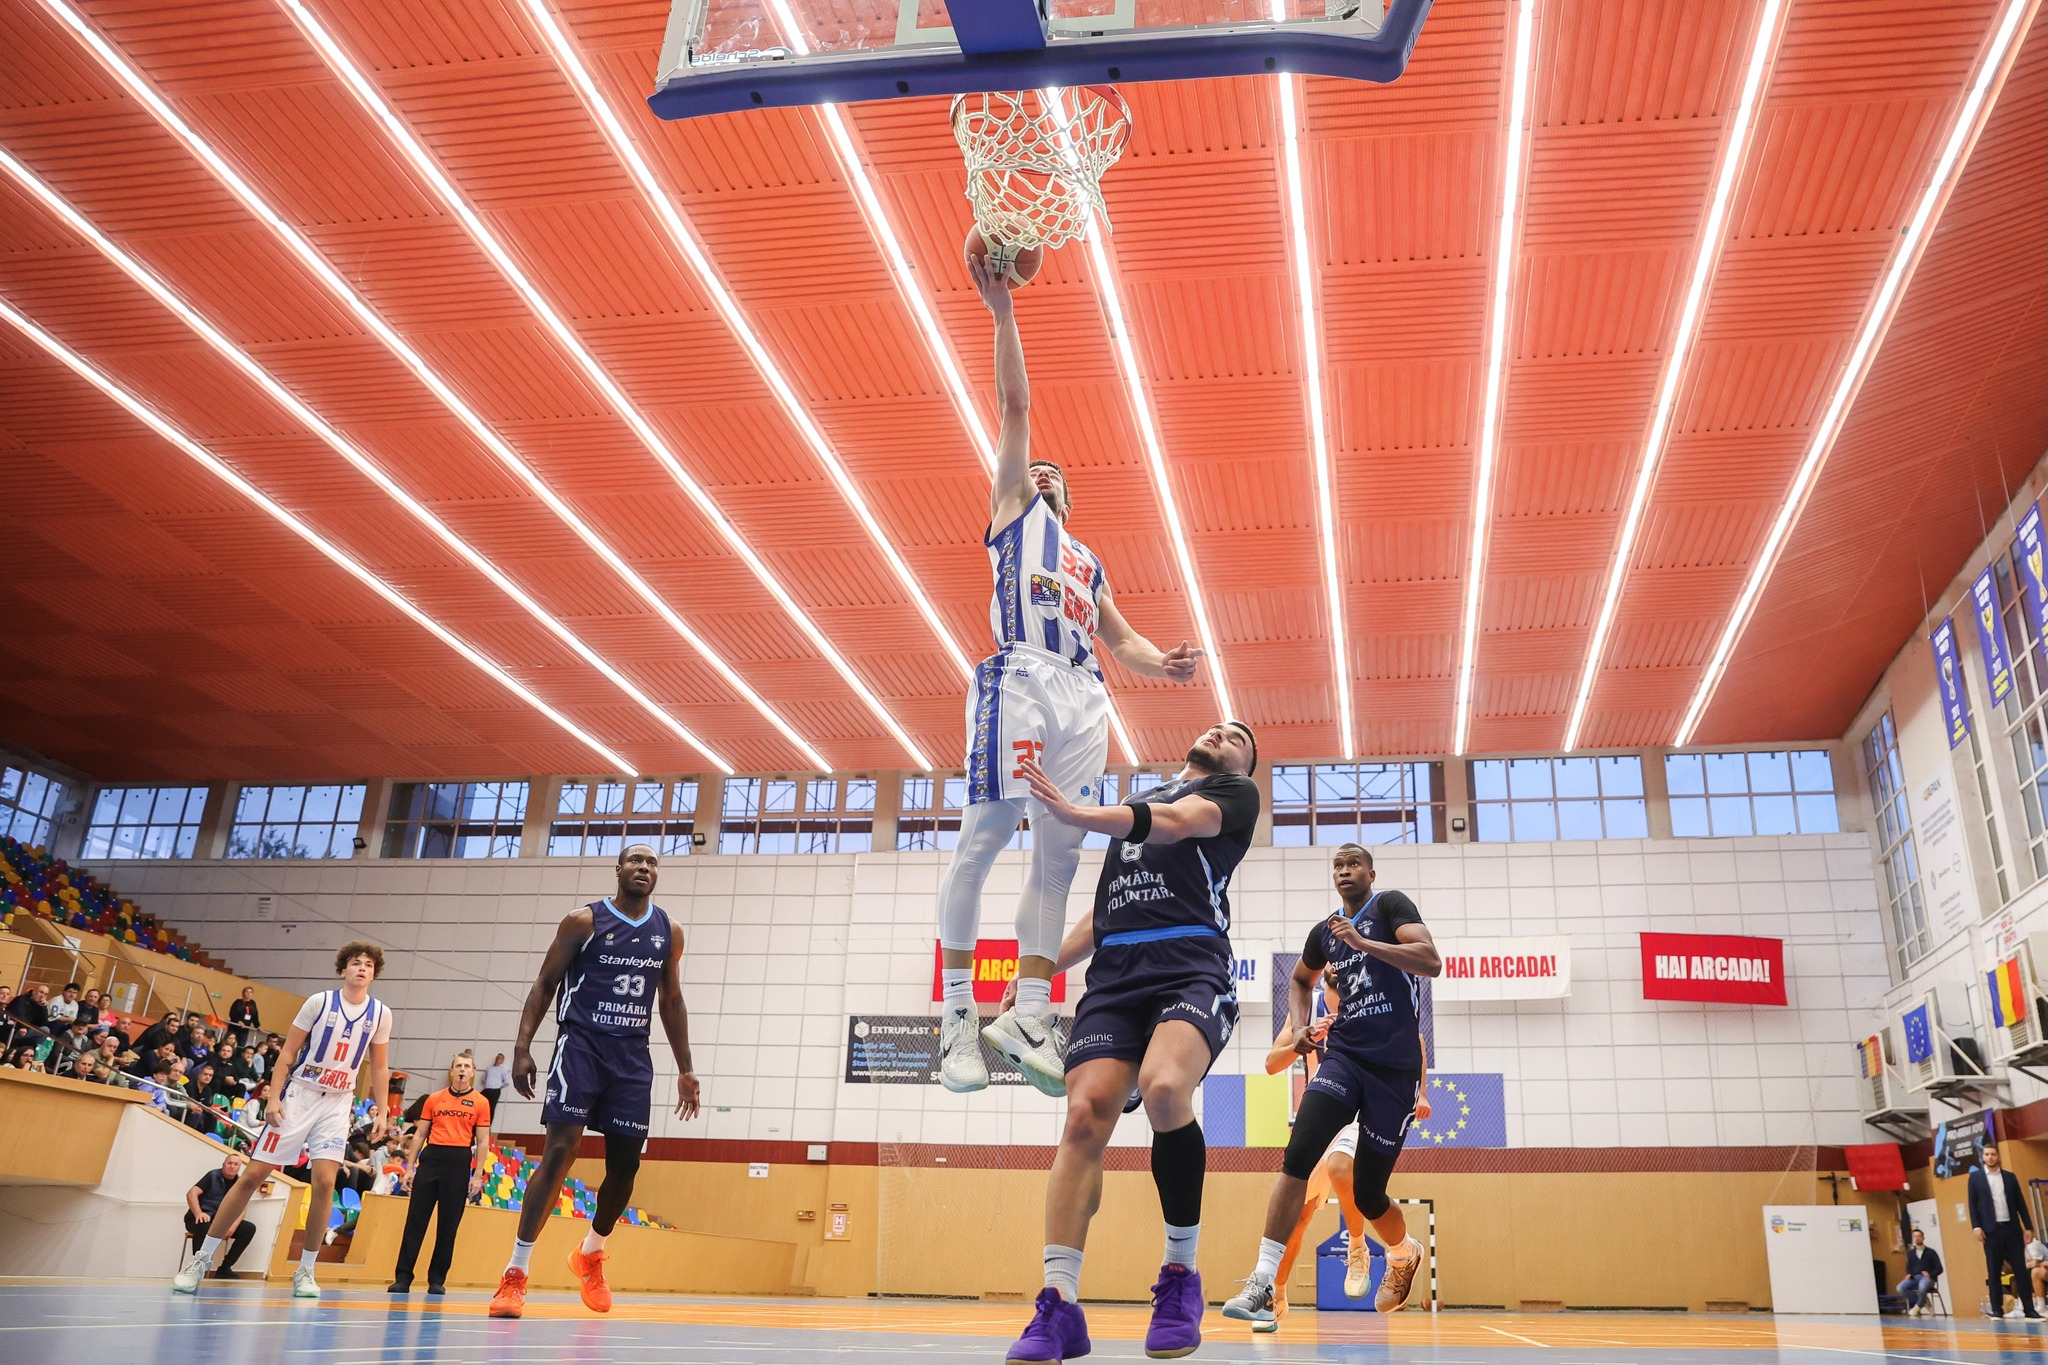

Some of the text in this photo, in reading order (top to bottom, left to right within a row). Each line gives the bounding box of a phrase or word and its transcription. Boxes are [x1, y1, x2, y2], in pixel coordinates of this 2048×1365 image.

[1061, 543, 1093, 588] 33
[1120, 841, 1143, 863] 8
[1445, 954, 1557, 978] HAI ARCADA!
[1655, 955, 1771, 983] HAI ARCADA!
[612, 974, 646, 998] 33
[1347, 966, 1372, 995] 24
[871, 1026, 930, 1035] EXTRUPLAST
[333, 1042, 350, 1062] 11
[851, 1070, 918, 1078] www.extruplast.ro
[990, 1071, 1027, 1082] SPOR
[433, 1109, 475, 1120] LINKSOFT
[613, 1117, 625, 1127] Pep
[262, 1131, 280, 1154] 11
